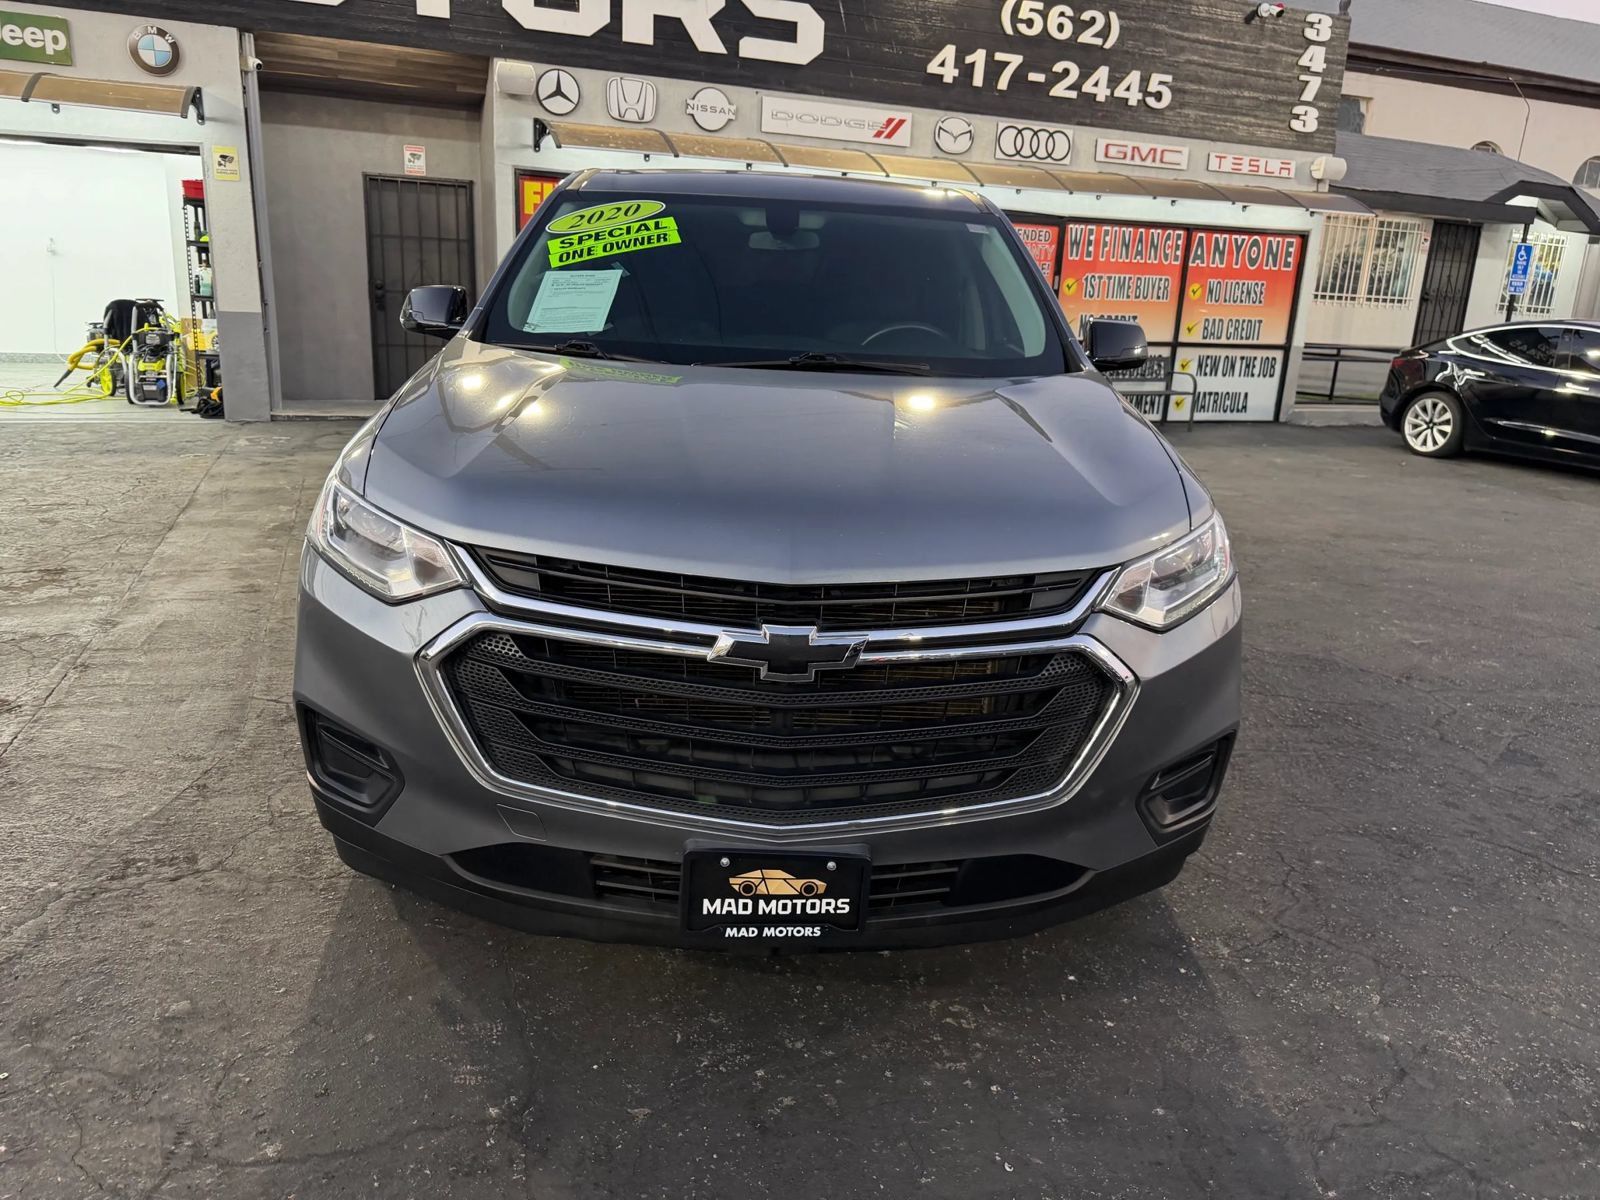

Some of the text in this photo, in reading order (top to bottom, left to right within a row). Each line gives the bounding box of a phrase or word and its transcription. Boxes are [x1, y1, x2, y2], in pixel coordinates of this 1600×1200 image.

[133, 26, 176, 44] BMW
[1001, 0, 1120, 49] (562)
[0, 24, 66, 56] eep
[926, 44, 1173, 109] 417-2445
[686, 103, 736, 116] NISSAN
[771, 110, 887, 131] DODGE
[1104, 142, 1184, 166] GMC
[1215, 154, 1291, 176] TESLA
[567, 203, 641, 230] 2020
[558, 232, 668, 263] ONE OWNER
[559, 220, 668, 249] SPECIAL
[1068, 224, 1096, 260] WE
[1099, 225, 1184, 264] FINANCE
[1189, 233, 1296, 271] ANYONE
[1083, 273, 1171, 302] 1ST TIME BUYER
[1206, 279, 1266, 305] NO LICENSE
[1202, 318, 1263, 341] BAD CREDIT
[1196, 355, 1277, 378] NEW ON THE JOB
[702, 898, 850, 915] MAD MOTORS
[725, 926, 821, 938] MAD MOTORS
